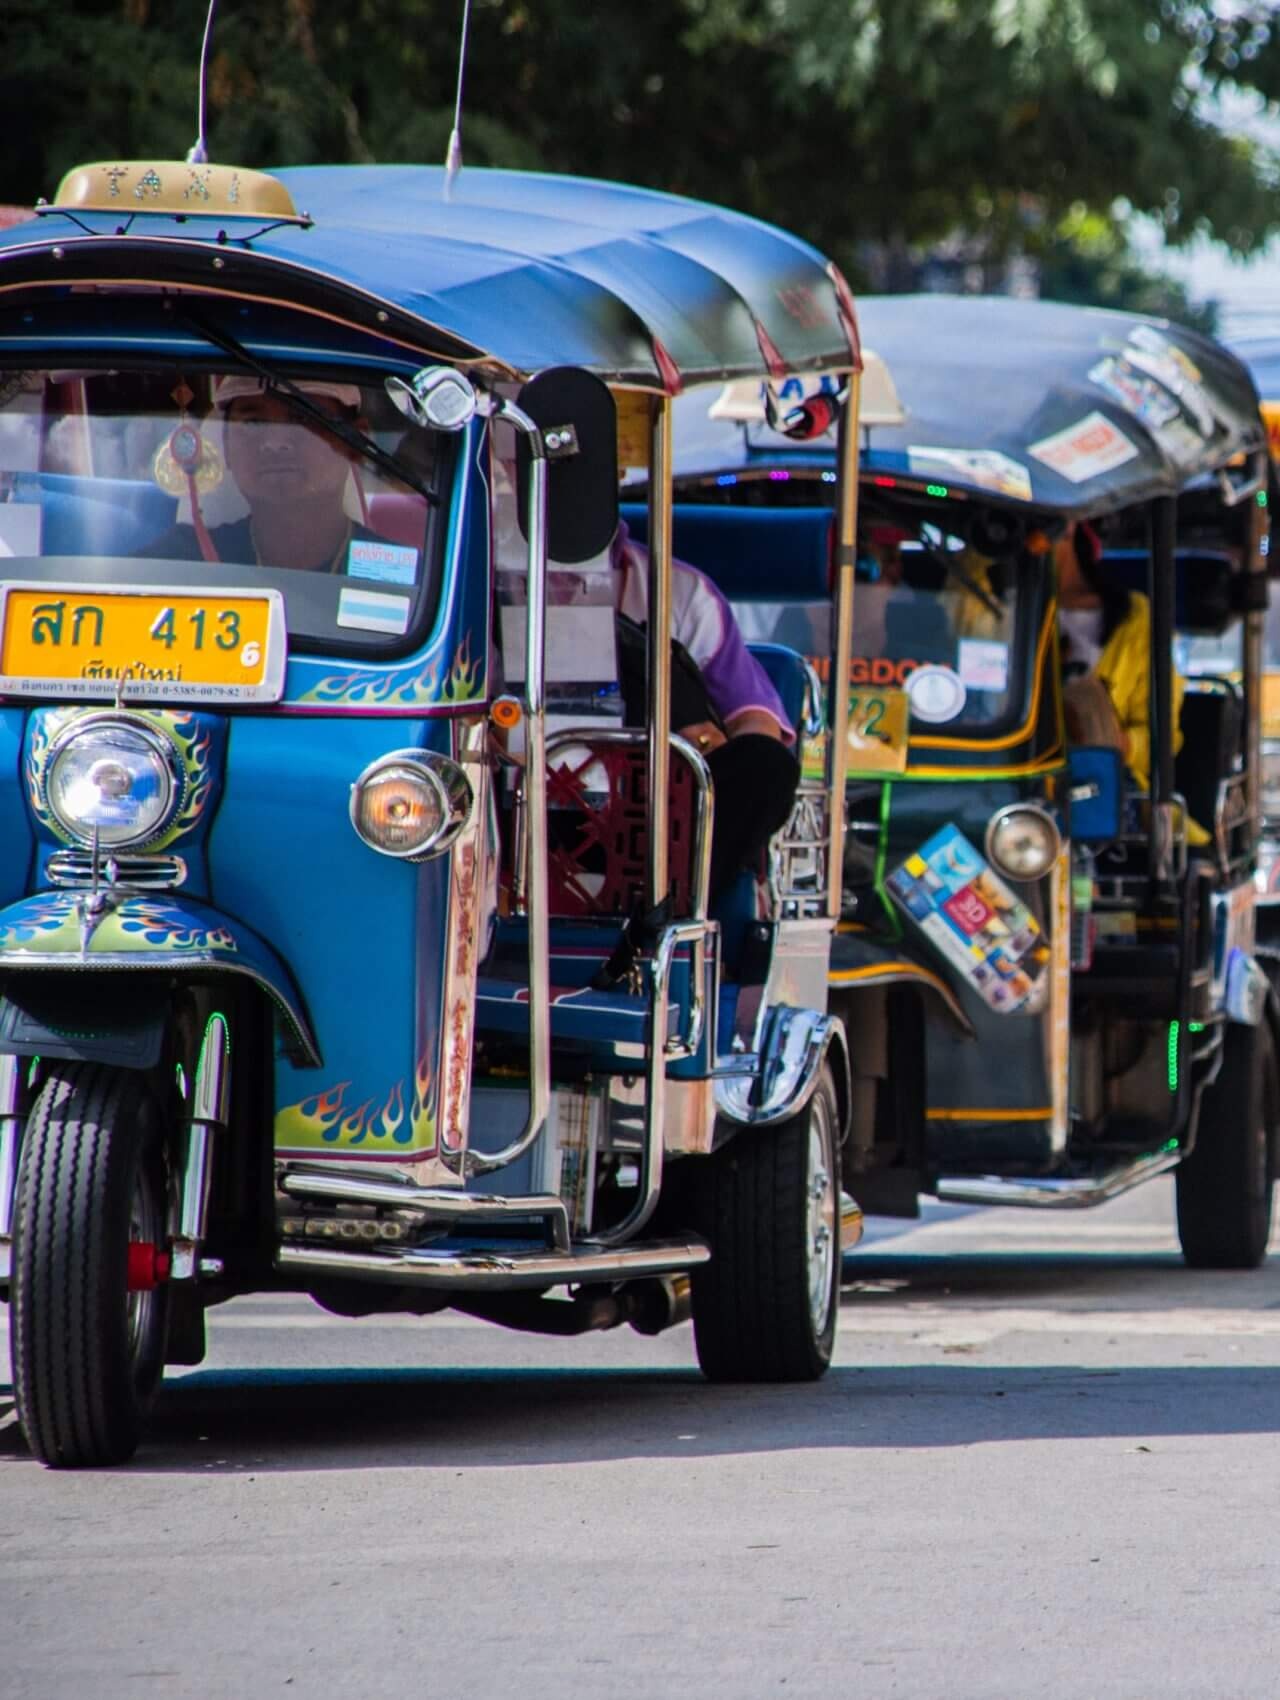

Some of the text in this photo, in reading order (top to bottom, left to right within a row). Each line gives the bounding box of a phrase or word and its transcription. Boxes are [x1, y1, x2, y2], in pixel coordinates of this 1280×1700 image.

[102, 165, 240, 203] TAXI
[31, 601, 241, 651] สก 413
[240, 641, 260, 667] 6
